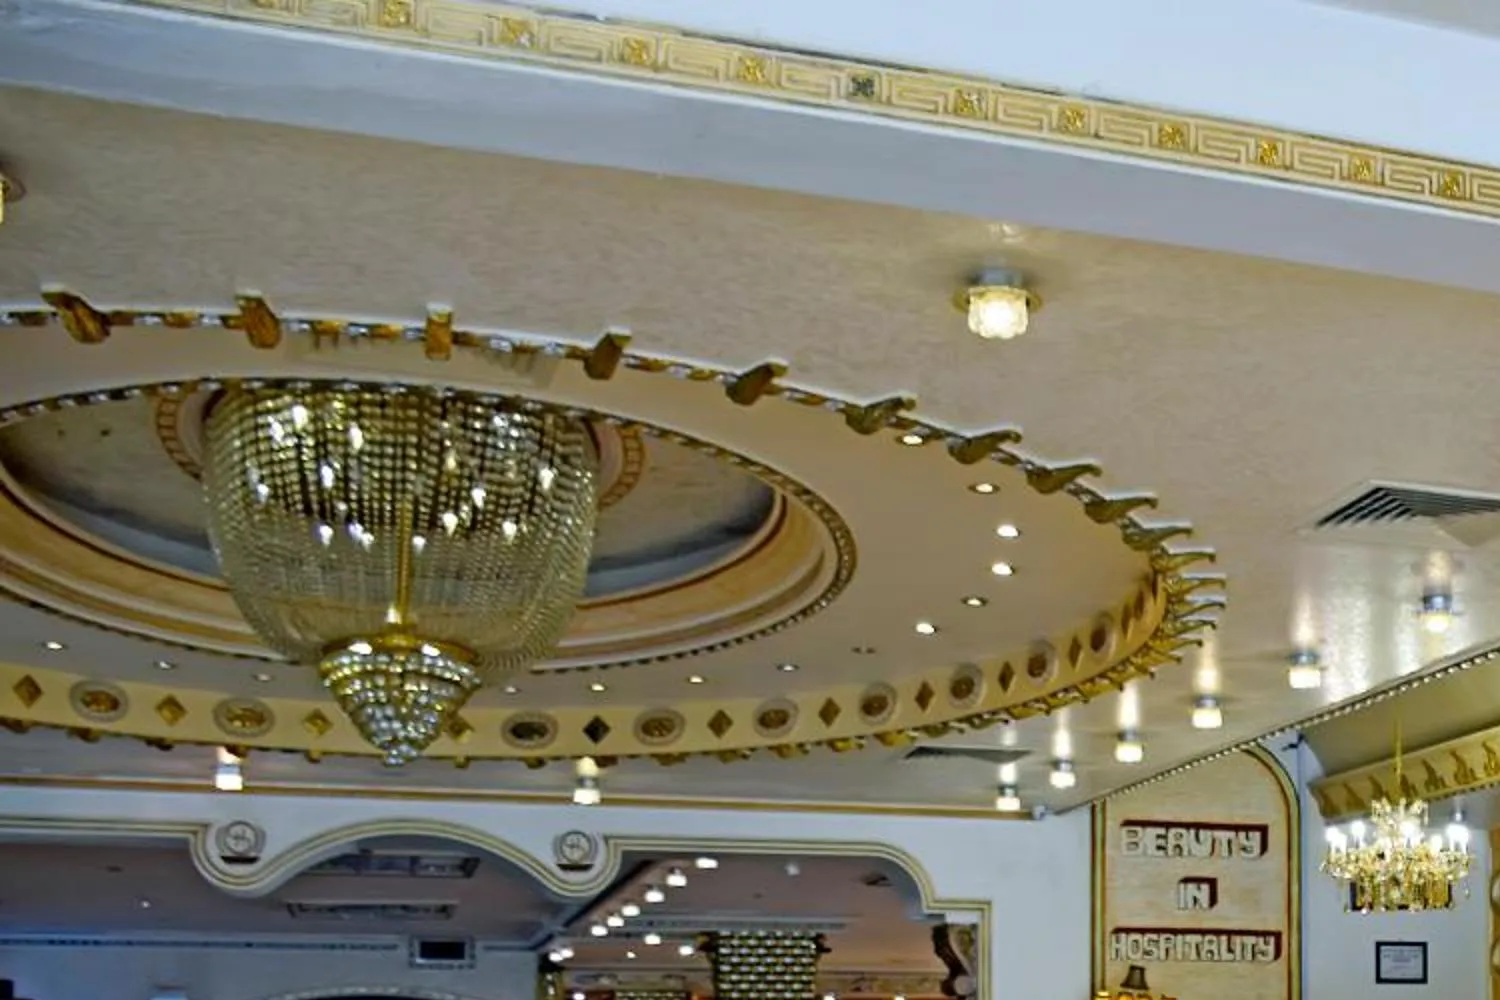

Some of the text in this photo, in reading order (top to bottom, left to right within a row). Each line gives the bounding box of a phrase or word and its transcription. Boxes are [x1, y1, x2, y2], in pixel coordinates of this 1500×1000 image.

[1120, 821, 1268, 859] BEAUTY
[1177, 878, 1216, 909] IN
[1109, 928, 1281, 962] HOSPITALITY
